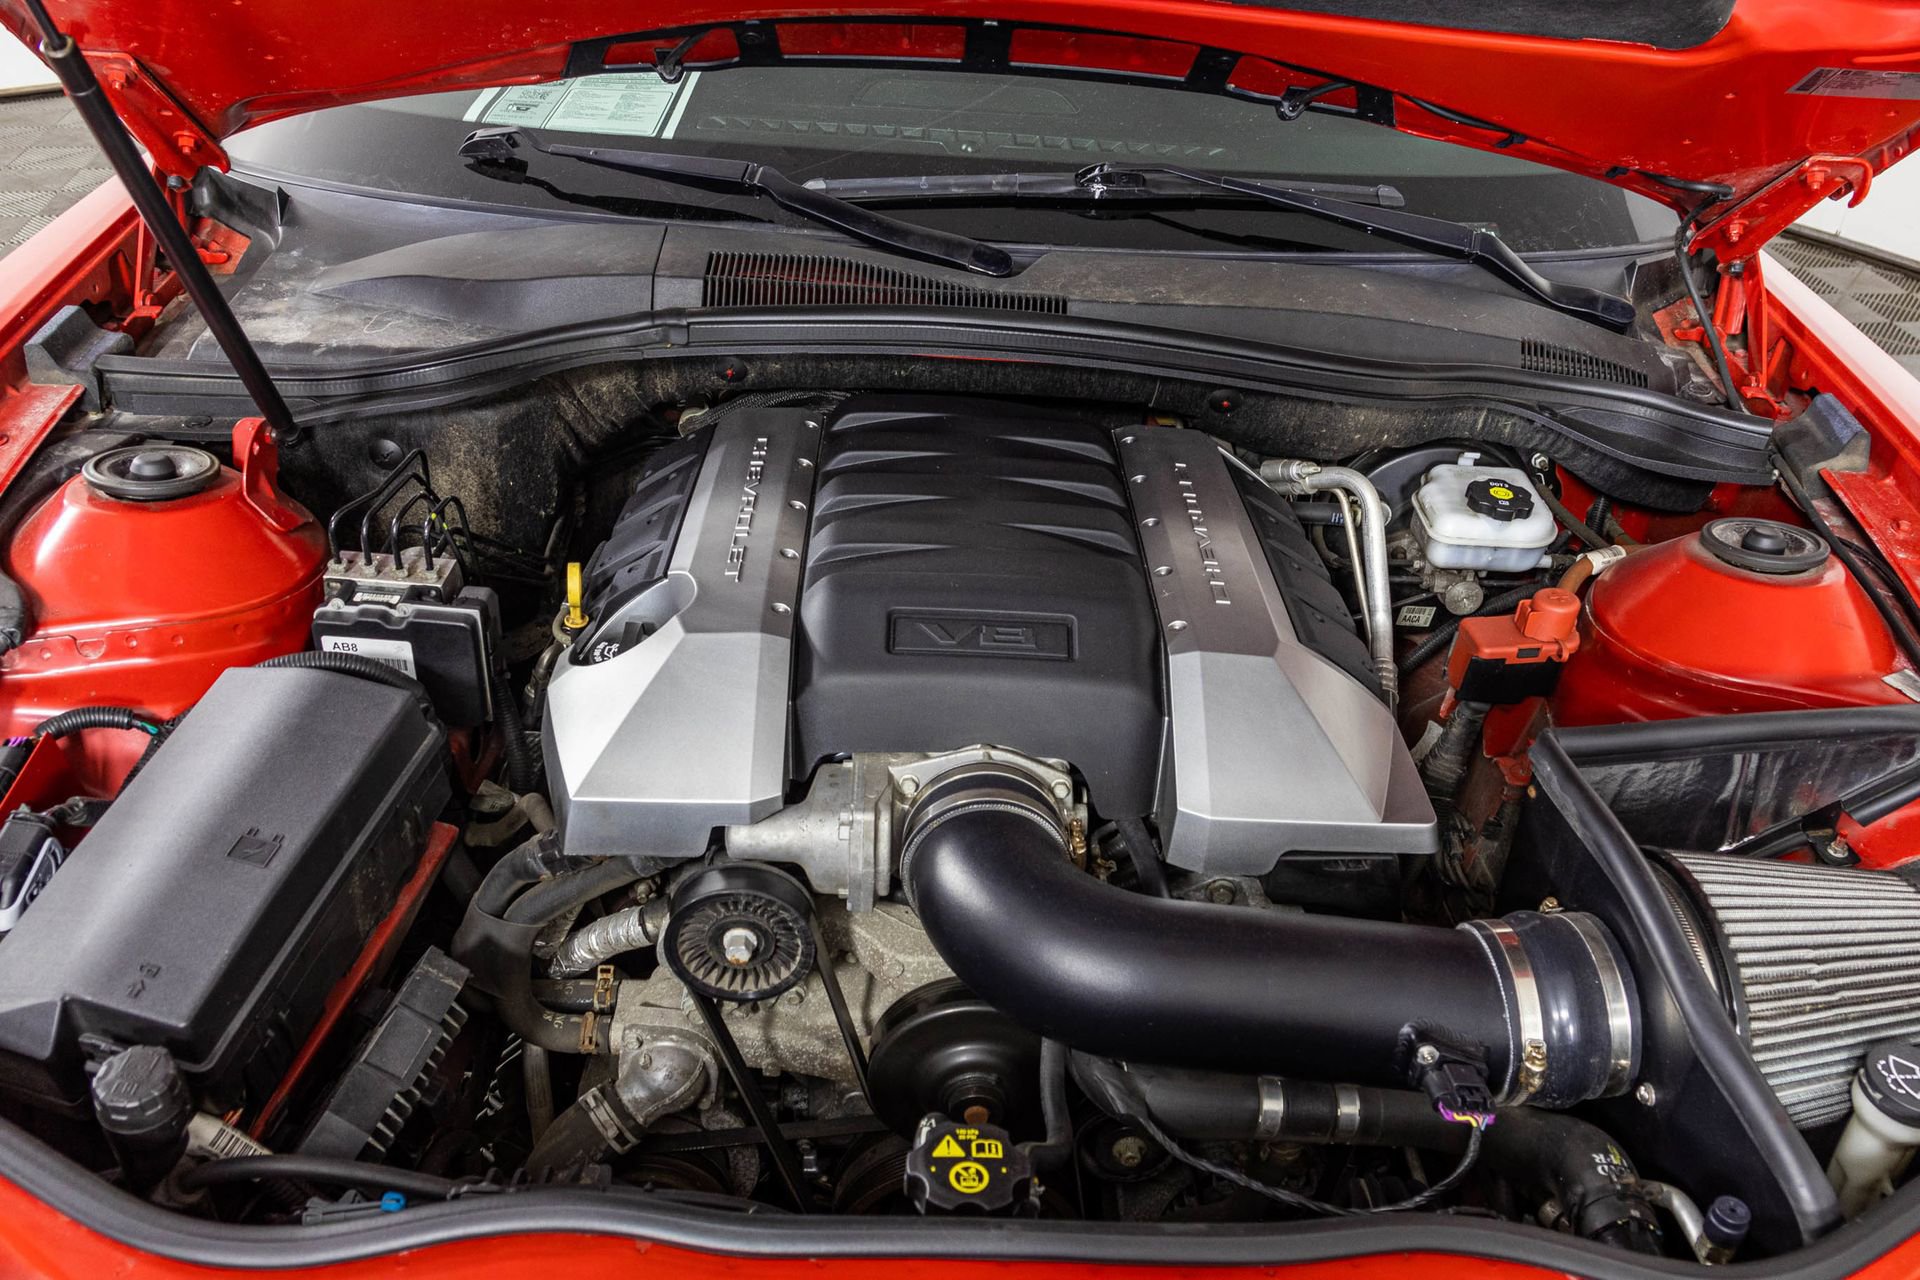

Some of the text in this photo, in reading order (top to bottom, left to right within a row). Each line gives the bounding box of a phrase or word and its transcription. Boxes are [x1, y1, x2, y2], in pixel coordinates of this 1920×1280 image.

[724, 437, 768, 583] CHEVROLET
[1174, 462, 1232, 605] CHEVROLET
[332, 641, 359, 653] AB8
[917, 622, 1038, 649] V8
